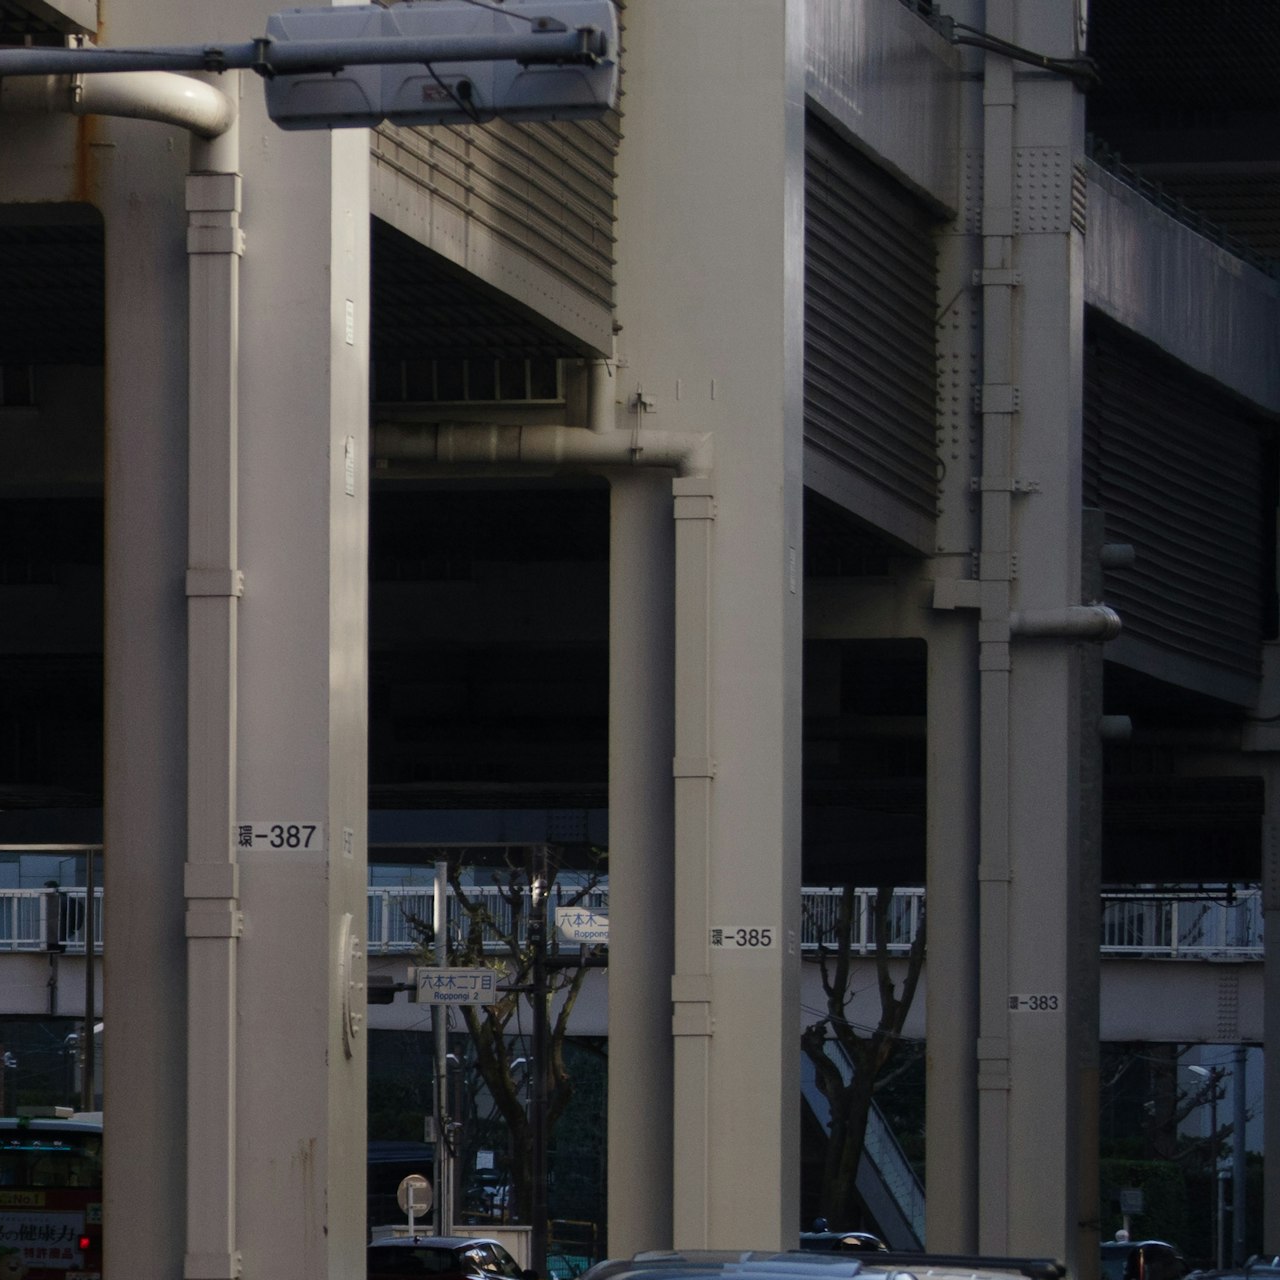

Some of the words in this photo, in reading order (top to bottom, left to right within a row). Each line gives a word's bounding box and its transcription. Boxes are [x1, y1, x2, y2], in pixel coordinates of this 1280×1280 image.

[238, 824, 316, 848] 環-387
[711, 928, 772, 947] 環-385
[422, 975, 492, 990] 六本木二丁目
[434, 991, 469, 1001] Roppongi
[474, 992, 479, 1000] 2
